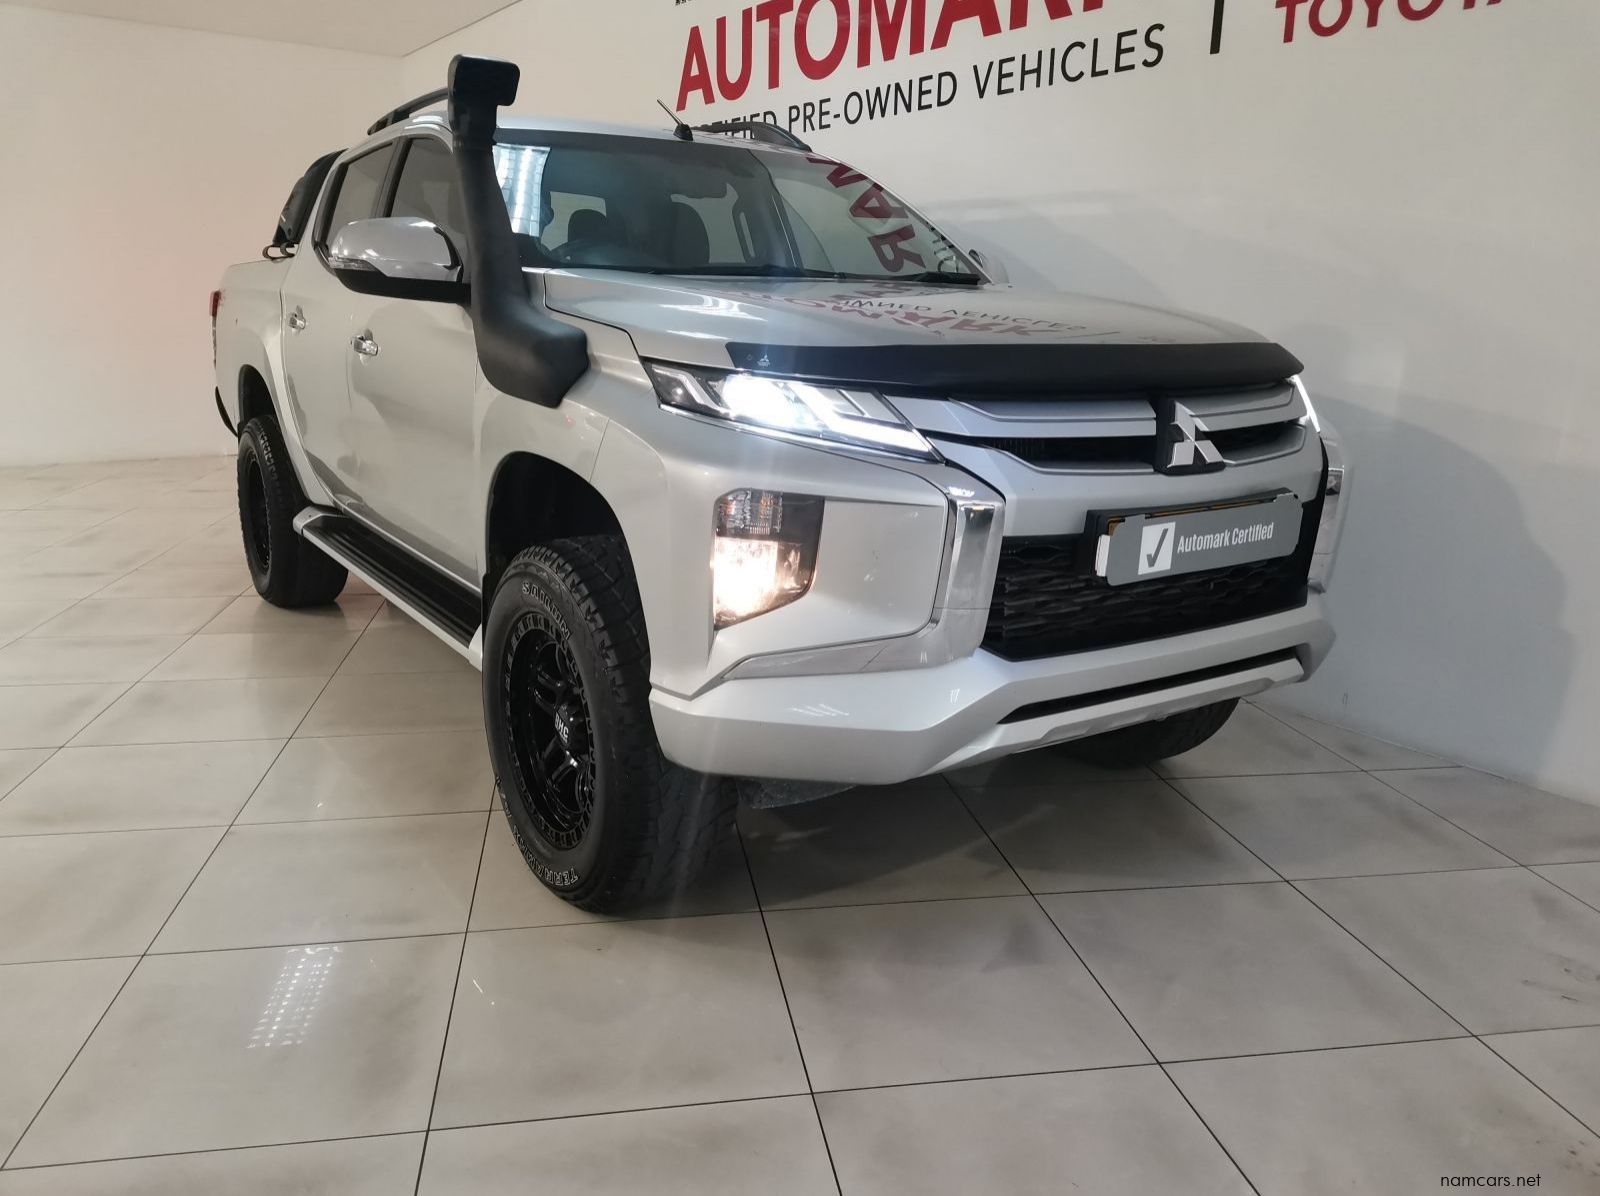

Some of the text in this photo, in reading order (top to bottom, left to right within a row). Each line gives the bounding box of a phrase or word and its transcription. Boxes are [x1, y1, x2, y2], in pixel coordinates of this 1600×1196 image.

[676, 0, 1103, 112] AUTOMA
[1275, 0, 1502, 43] TOYO
[788, 72, 958, 133] PRE-OWNED
[973, 23, 1166, 101] VEHICLES
[1177, 522, 1274, 554] Automark Certified
